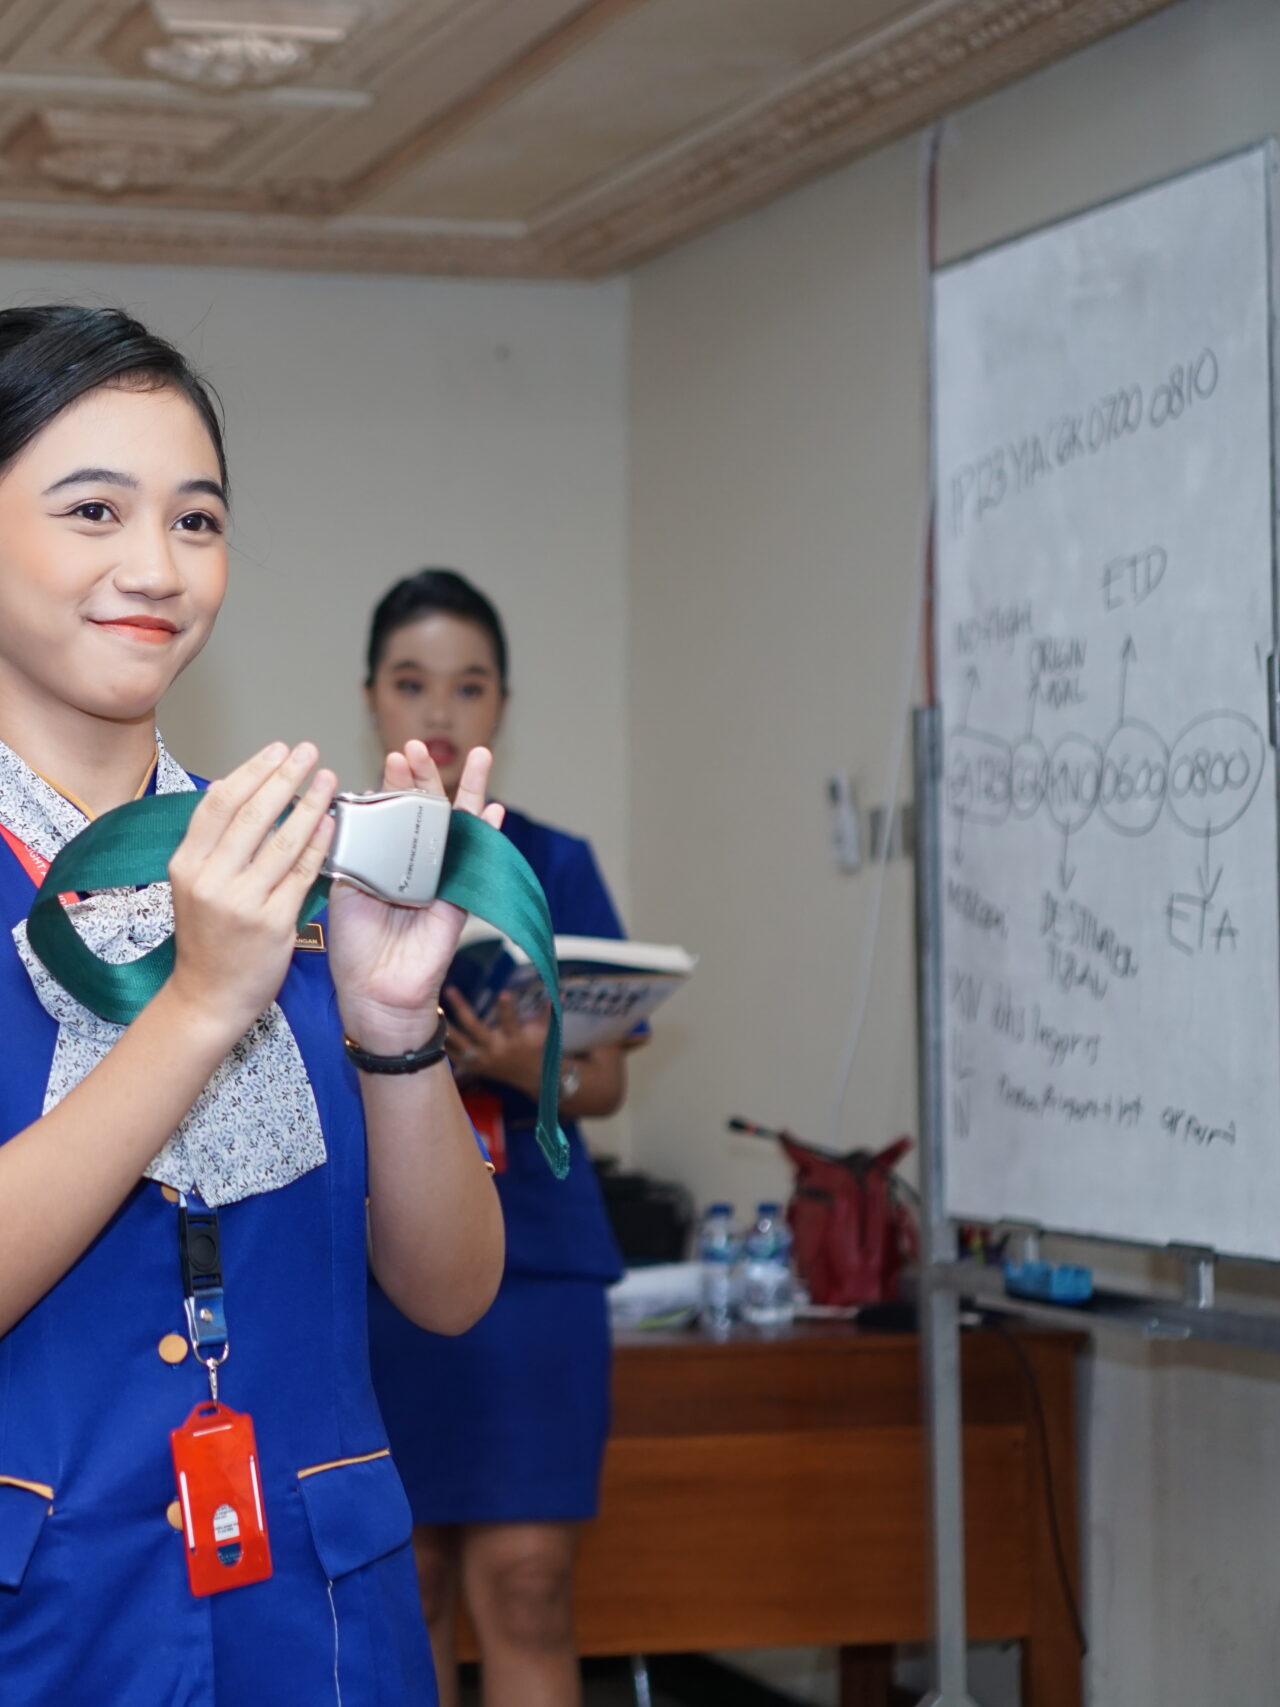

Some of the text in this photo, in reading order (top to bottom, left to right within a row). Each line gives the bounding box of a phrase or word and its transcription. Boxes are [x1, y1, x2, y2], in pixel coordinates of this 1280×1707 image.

[1150, 346, 1219, 430] 0810
[1101, 544, 1168, 612] ETD
[1172, 747, 1251, 799] 0800
[1165, 892, 1240, 958] ETA
